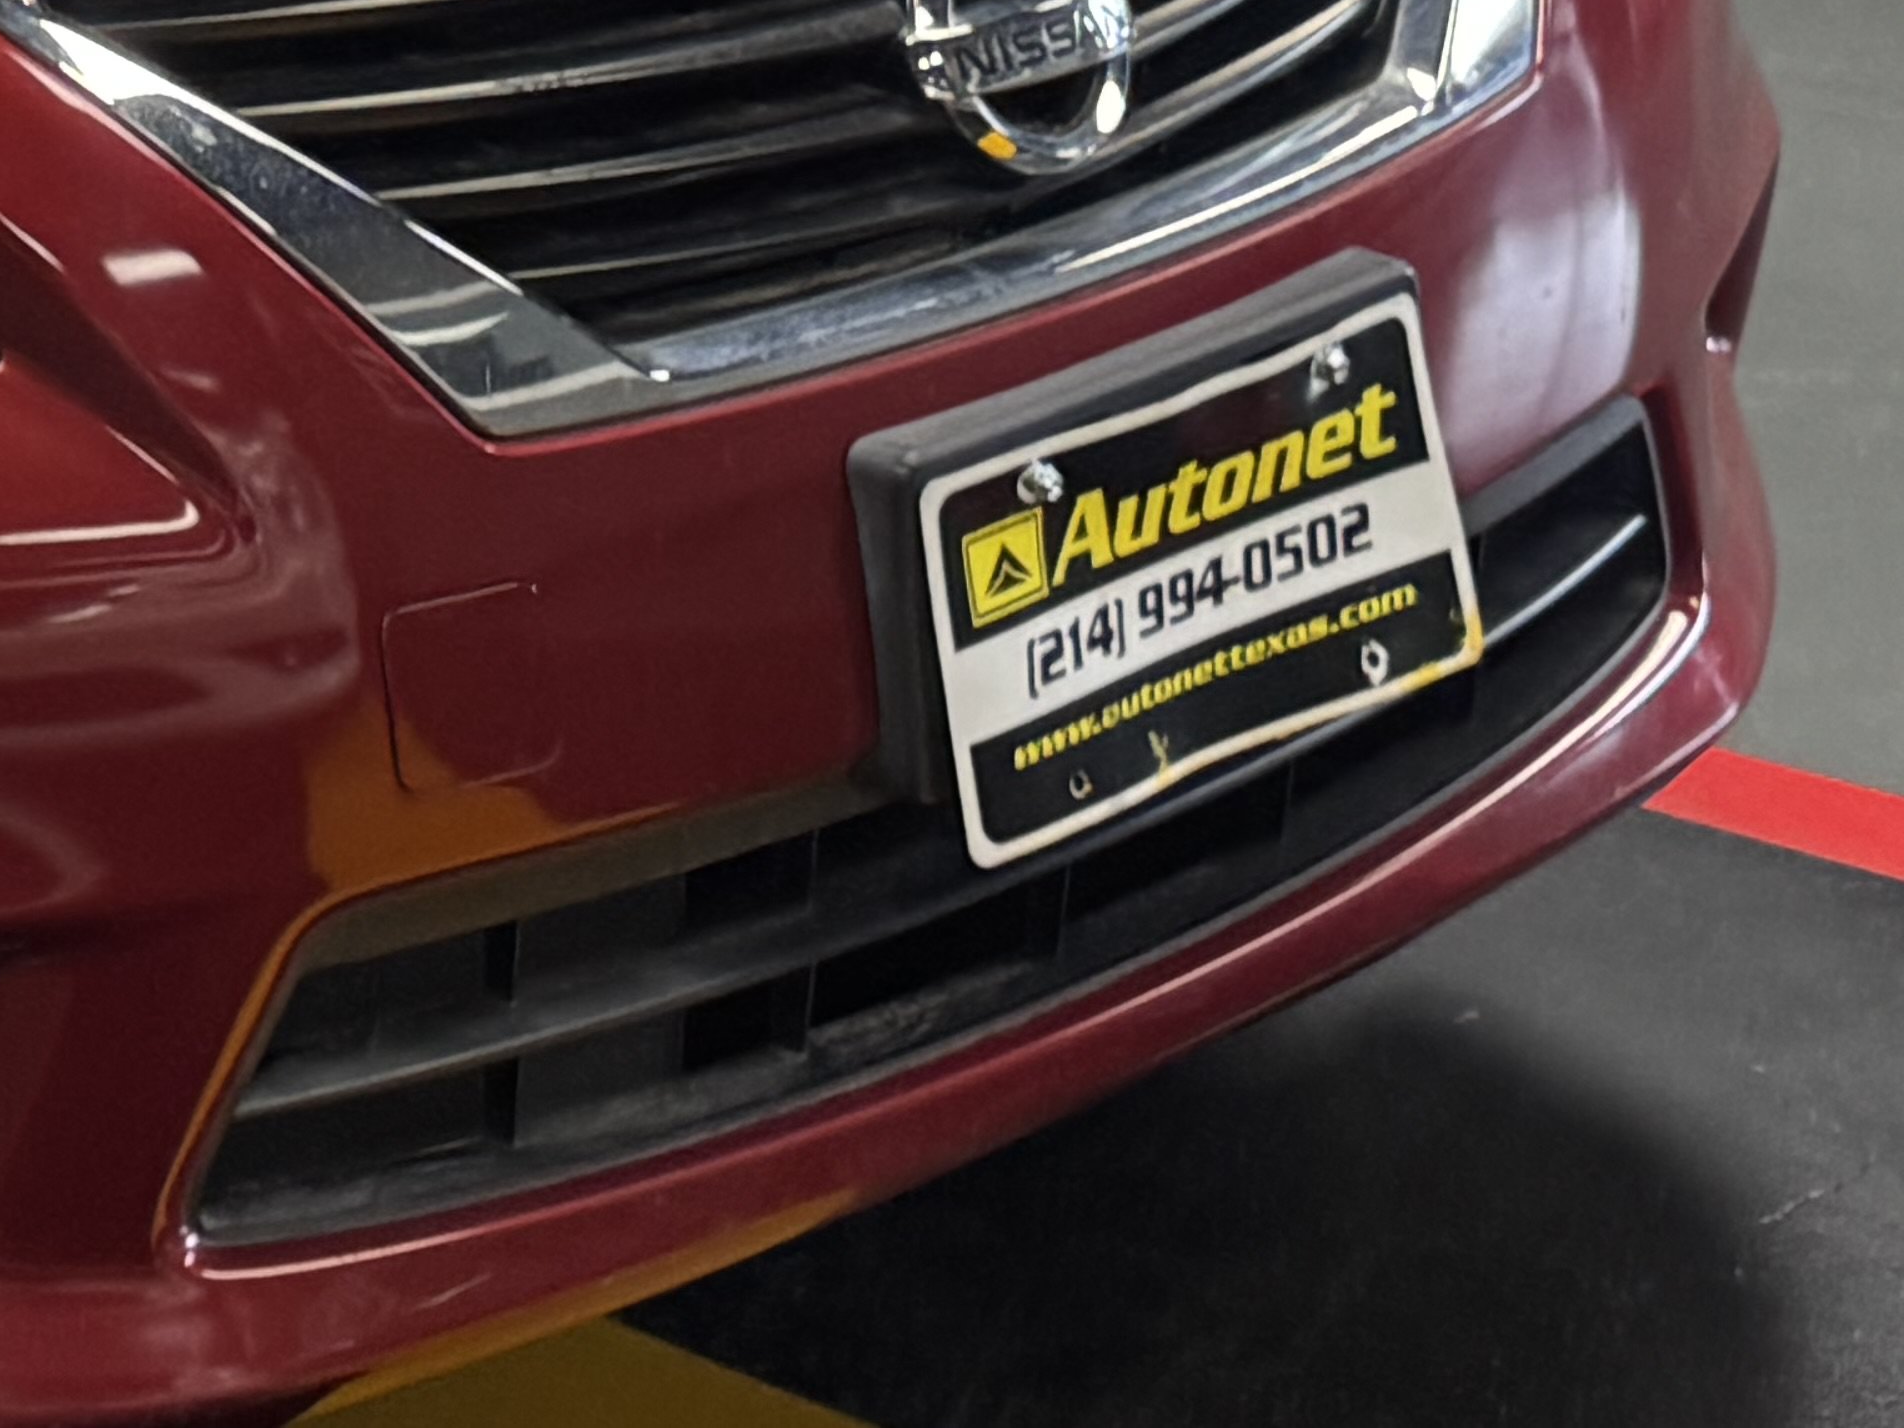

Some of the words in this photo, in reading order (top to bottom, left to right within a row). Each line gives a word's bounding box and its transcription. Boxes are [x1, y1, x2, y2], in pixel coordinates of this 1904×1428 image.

[1052, 381, 1397, 587] Autonet
[1013, 582, 1419, 771] www.autonettexas.com
[1026, 598, 1126, 700] (214)
[1138, 501, 1373, 639] 994-0502
